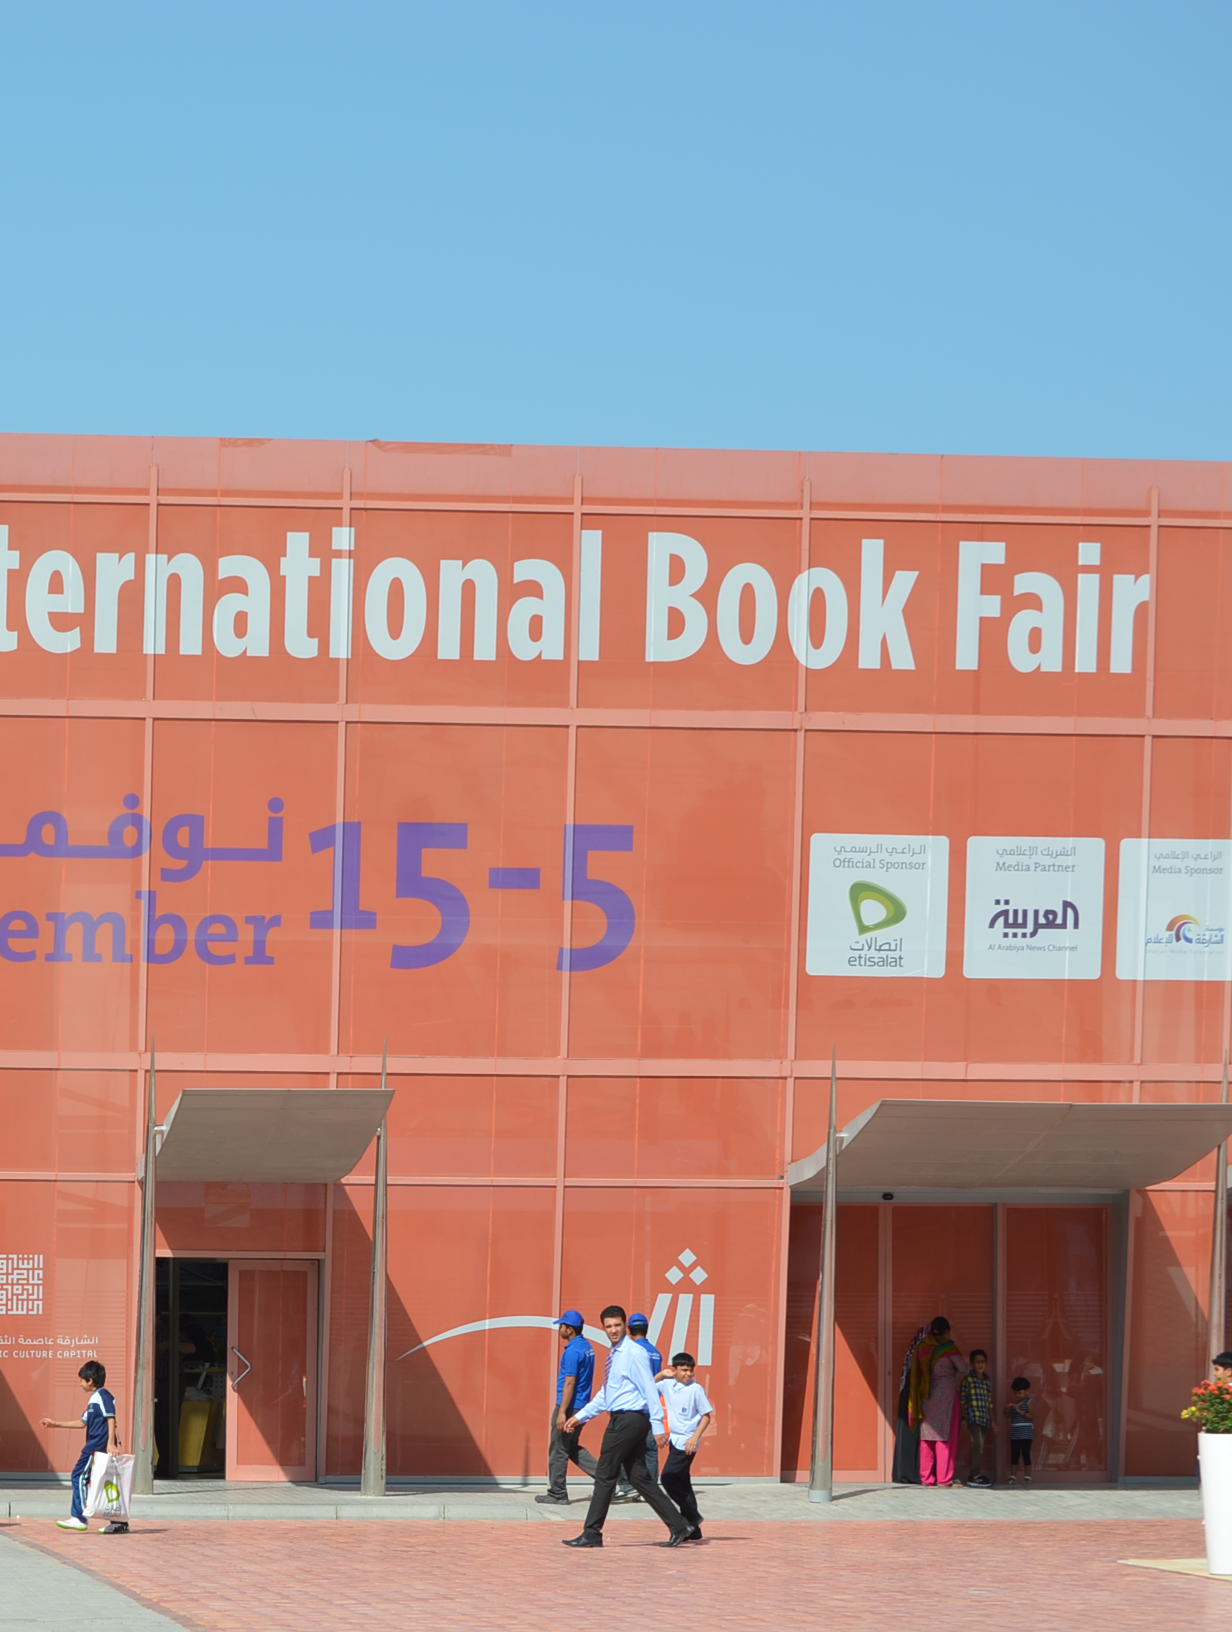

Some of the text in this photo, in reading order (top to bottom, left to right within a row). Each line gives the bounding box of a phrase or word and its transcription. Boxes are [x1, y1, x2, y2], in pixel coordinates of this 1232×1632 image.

[645, 532, 919, 670] Book
[955, 541, 1151, 674] Fair
[832, 857, 927, 872] Official Sponsor
[994, 861, 1077, 873] Media Partner
[1152, 865, 1224, 877] Media Sponsor
[988, 899, 1080, 939] العربية
[849, 936, 904, 953] اتصالات
[1026, 943, 1046, 952] News
[1047, 943, 1079, 952] Channel
[847, 953, 905, 968] etisalat
[12, 1349, 54, 1360] CULTURE
[56, 1349, 99, 1360] CAPITAL
